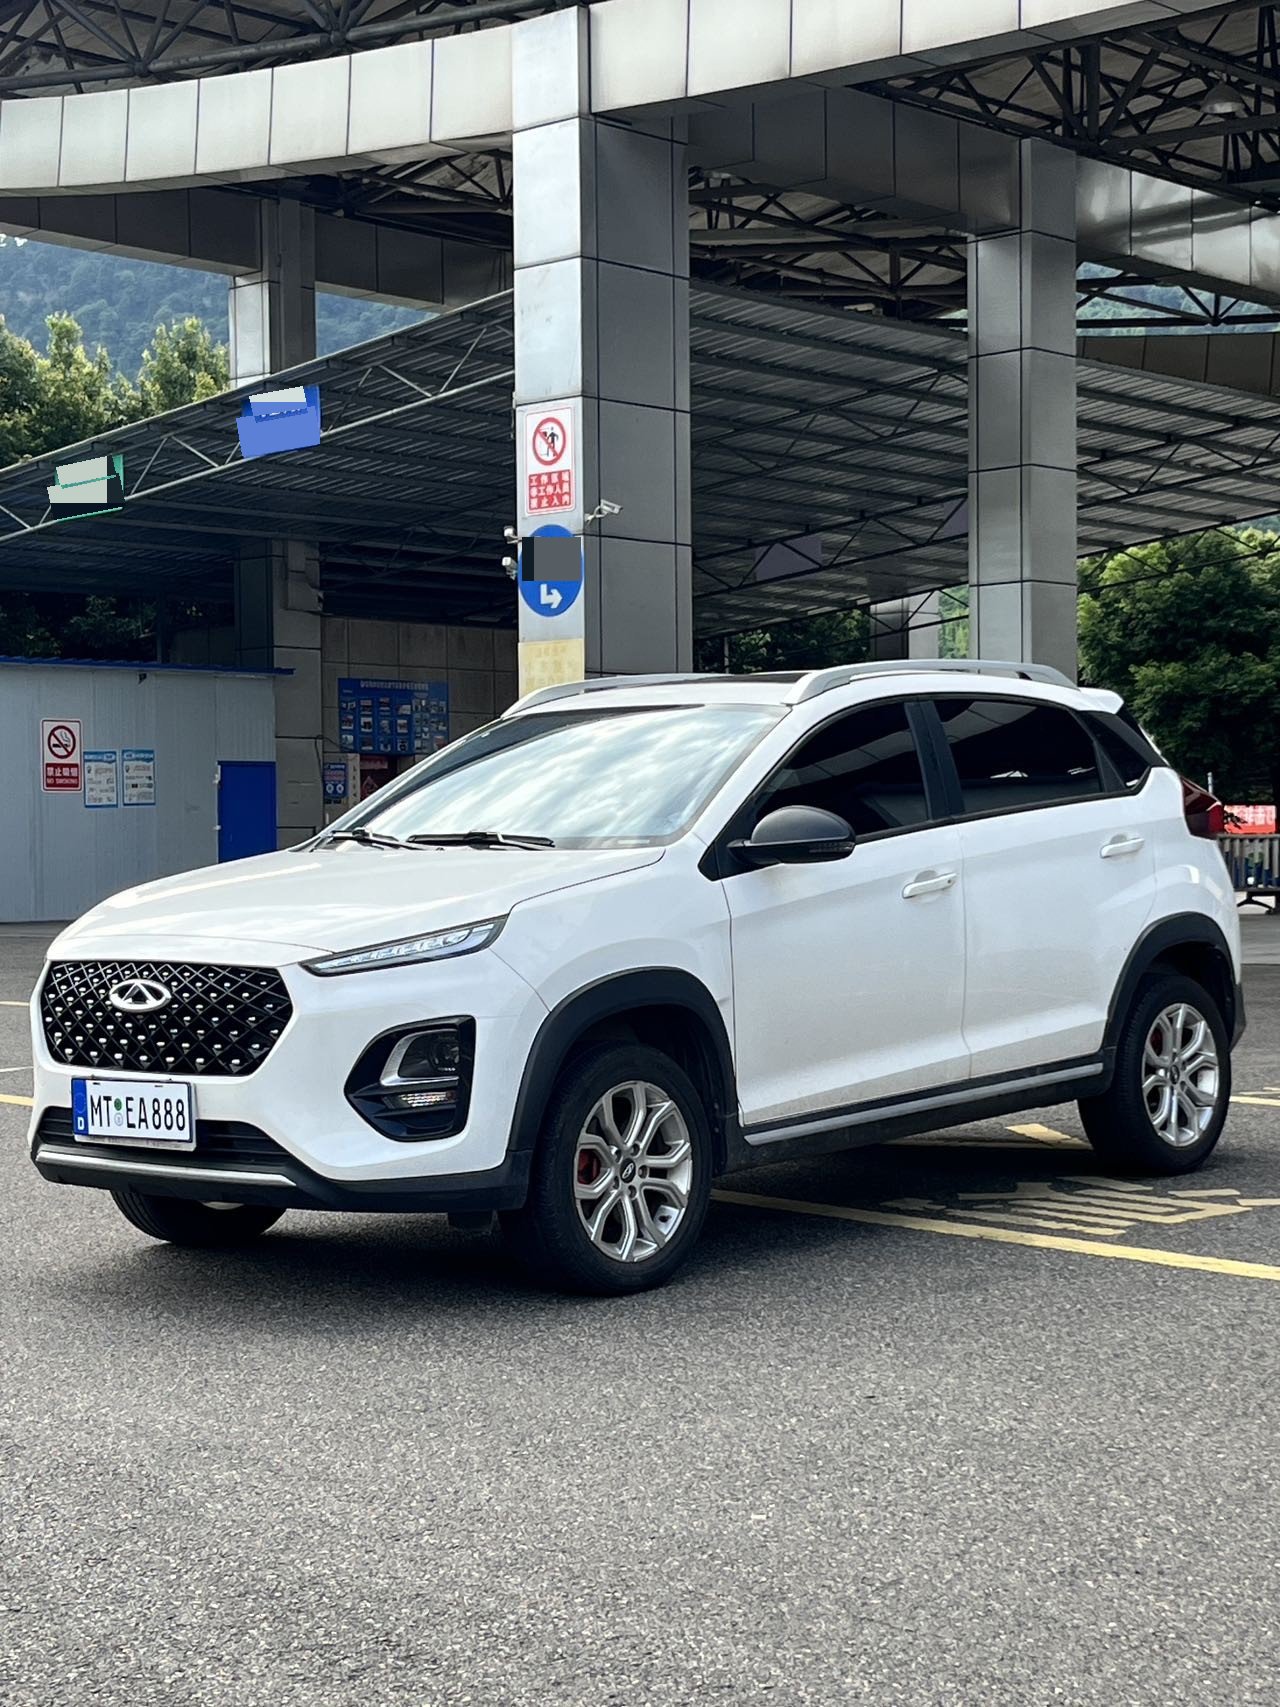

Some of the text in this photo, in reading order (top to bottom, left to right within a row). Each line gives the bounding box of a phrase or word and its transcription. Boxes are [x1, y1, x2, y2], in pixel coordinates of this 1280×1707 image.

[77, 1116, 84, 1130] D
[90, 1095, 186, 1131] MT EA888
